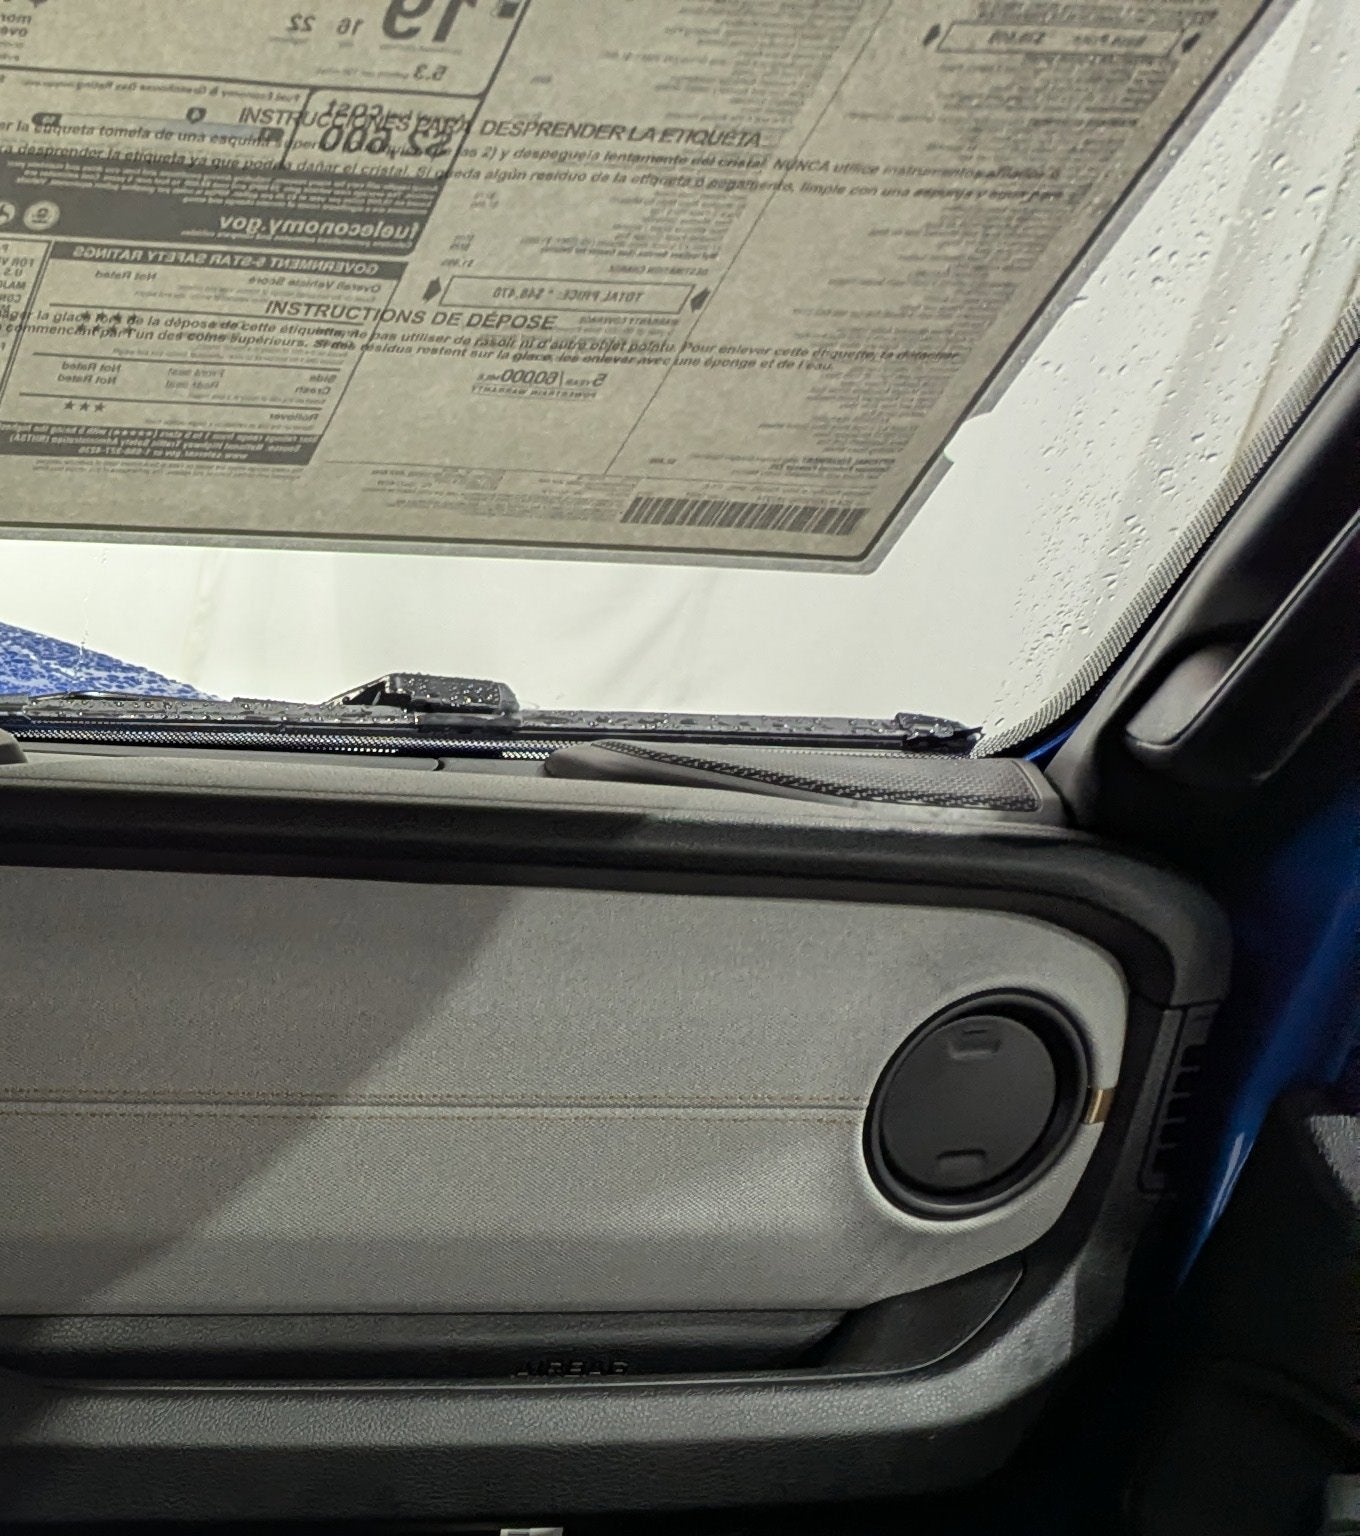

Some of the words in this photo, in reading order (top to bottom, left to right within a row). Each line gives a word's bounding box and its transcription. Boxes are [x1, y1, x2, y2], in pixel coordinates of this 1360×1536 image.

[16, 121, 30, 133] la
[155, 128, 173, 140] de
[238, 106, 410, 132] INSTRUCCIONES
[480, 119, 627, 141] DESPRENDER
[628, 127, 657, 142] LA
[658, 126, 761, 147] ETIQUETA
[36, 310, 50, 322] la
[265, 300, 427, 325] INSTRUCTIONS
[431, 312, 463, 327] DE
[466, 311, 558, 331] DÉPOSE
